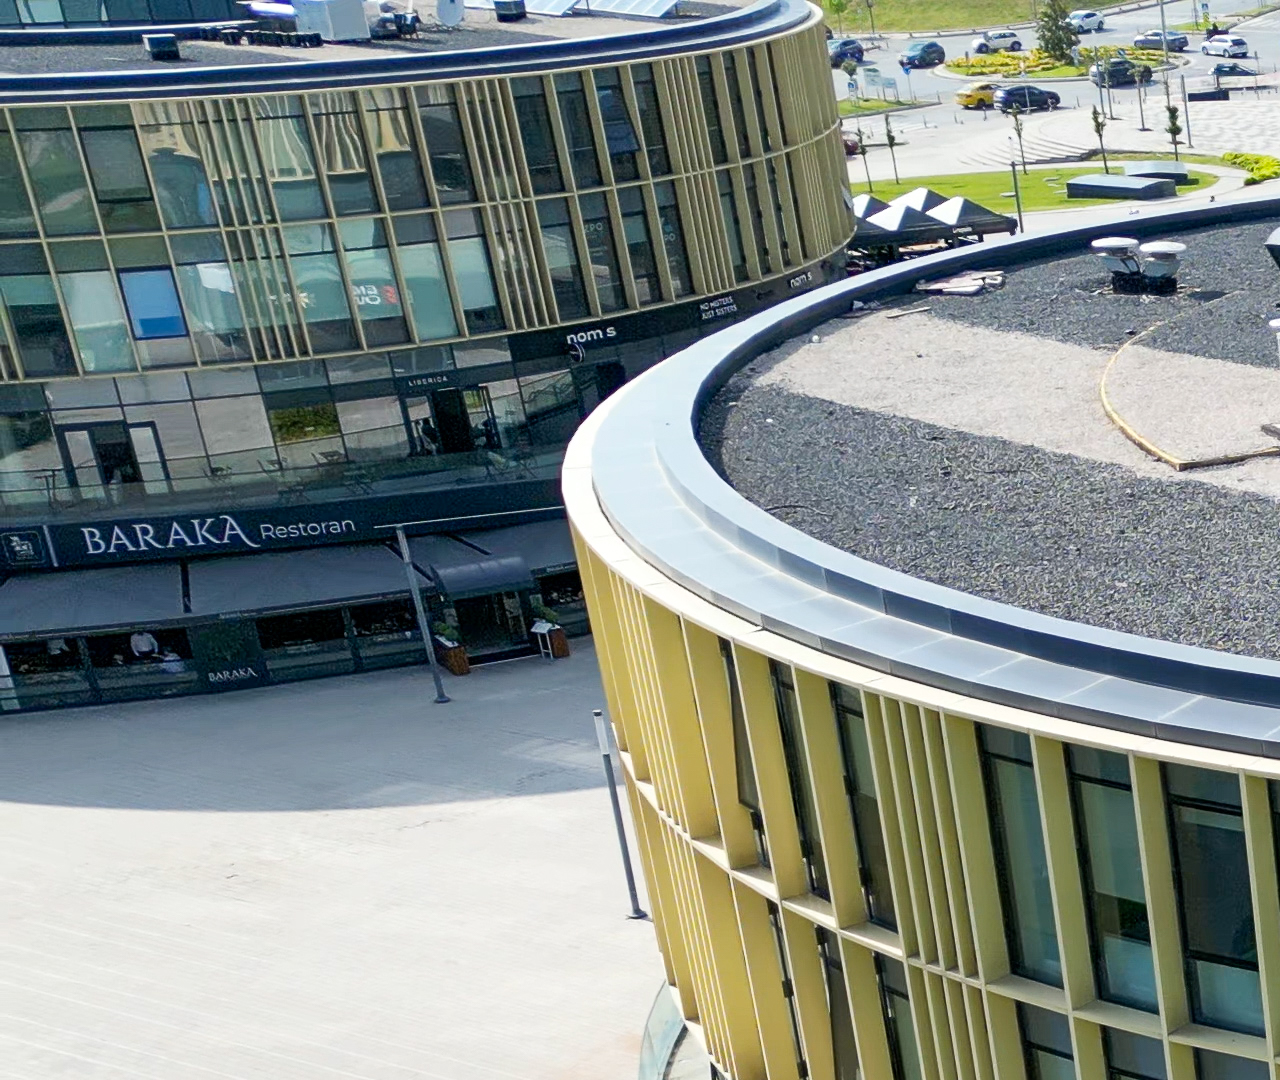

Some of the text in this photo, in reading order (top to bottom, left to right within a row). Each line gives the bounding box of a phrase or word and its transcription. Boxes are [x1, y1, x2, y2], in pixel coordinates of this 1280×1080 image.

[81, 515, 356, 554] BARAKA Restoran
[208, 667, 258, 683] BARAKA
